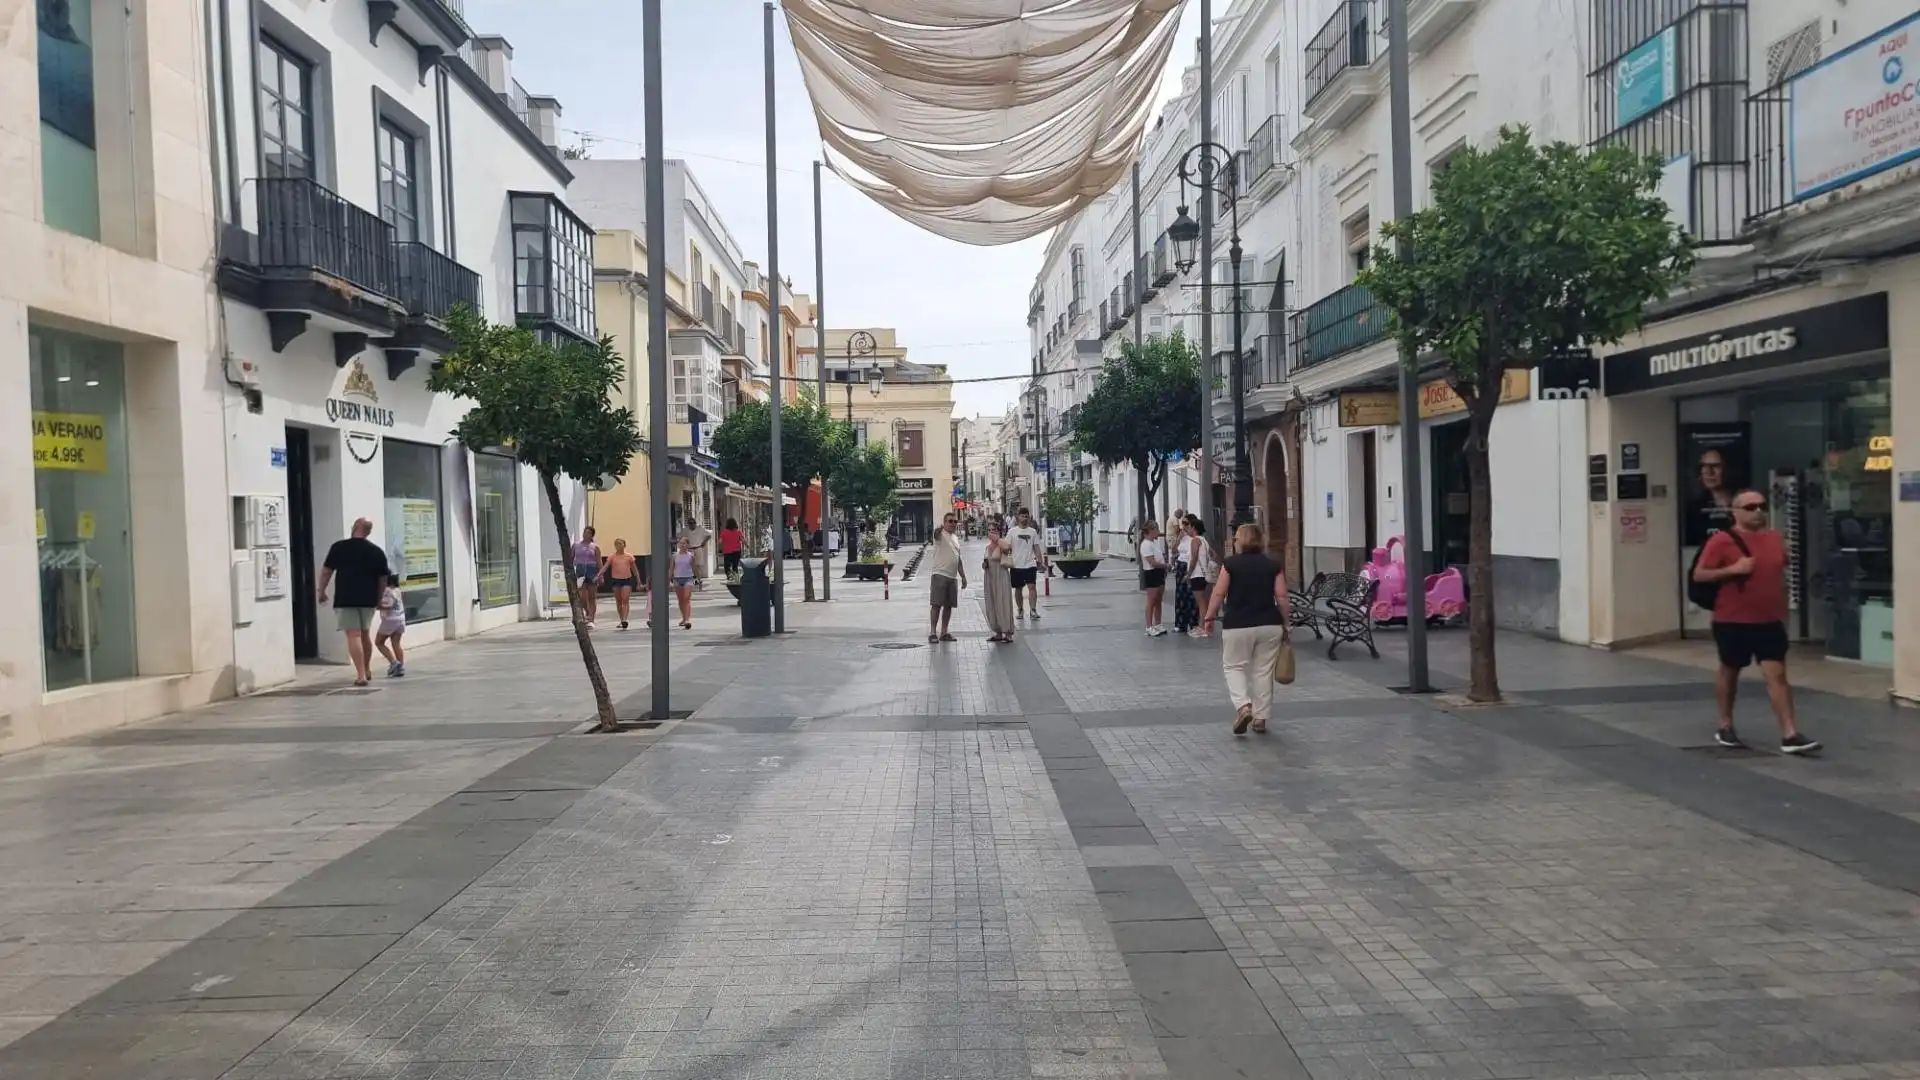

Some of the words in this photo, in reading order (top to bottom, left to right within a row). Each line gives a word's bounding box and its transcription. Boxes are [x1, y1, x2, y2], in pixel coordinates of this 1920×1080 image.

[326, 398, 361, 423] QUEEN
[364, 405, 394, 427] NAILS
[49, 422, 103, 440] VERANO
